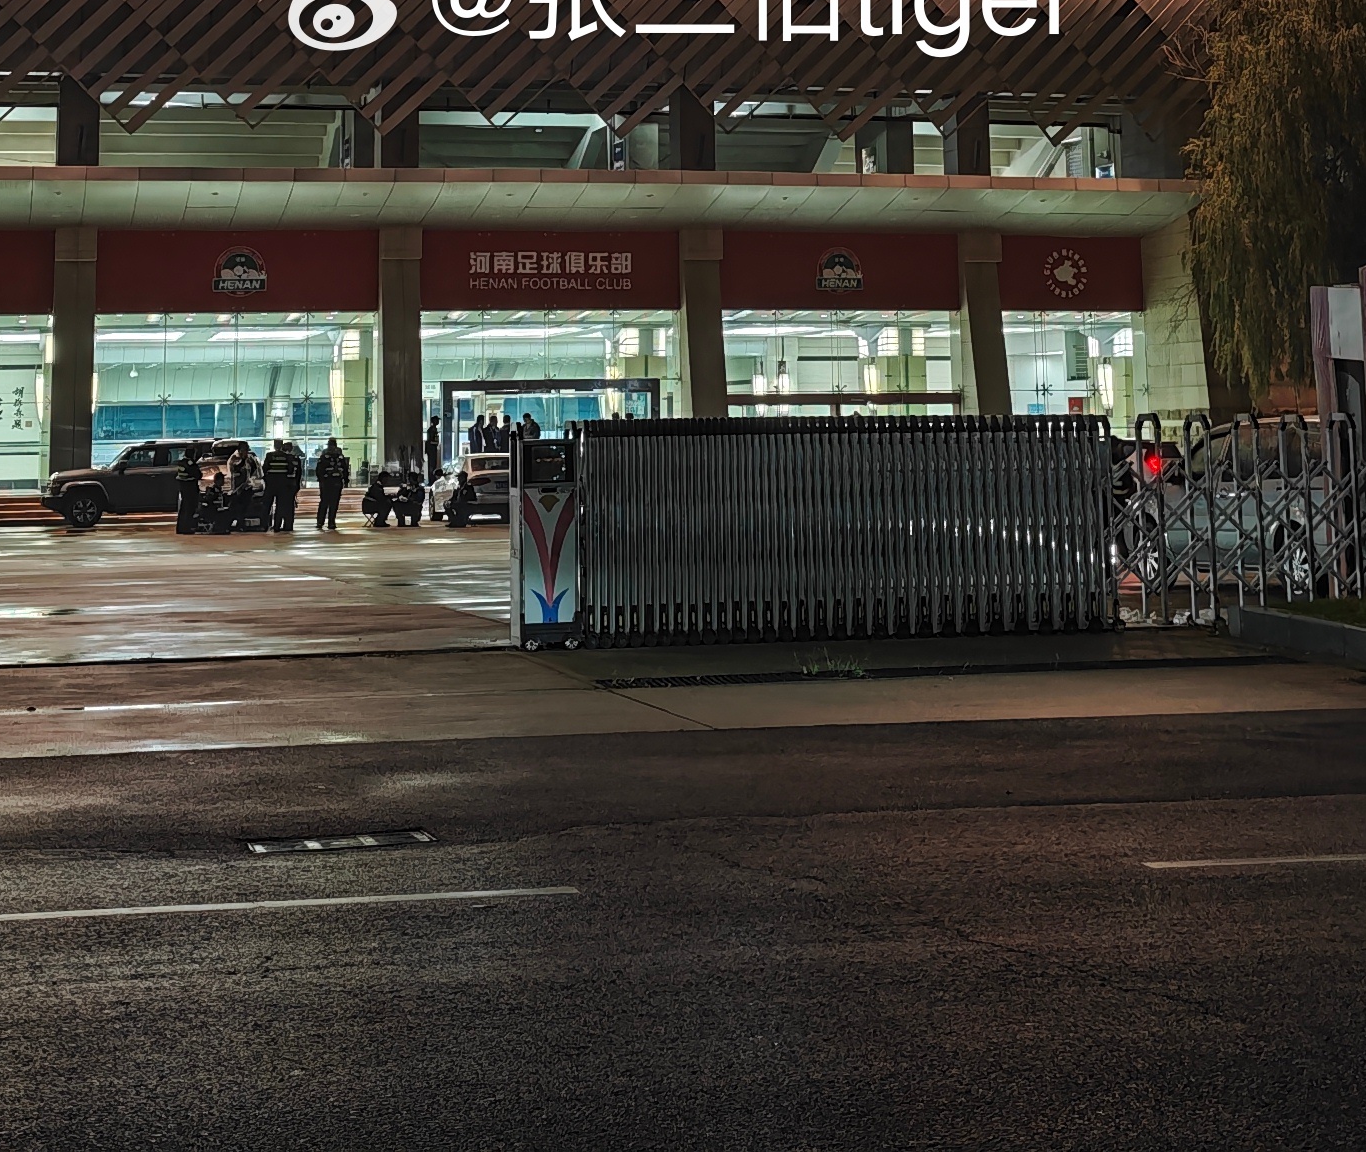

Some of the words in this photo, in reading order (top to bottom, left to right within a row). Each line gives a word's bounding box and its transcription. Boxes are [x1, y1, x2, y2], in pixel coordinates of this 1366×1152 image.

[469, 251, 632, 275] 河南足球俱乐部
[218, 279, 261, 290] HENAN
[469, 277, 518, 290] HENAN
[521, 277, 592, 290] FOOTBALL
[595, 277, 632, 290] CLUB
[821, 278, 858, 288] HENAN
